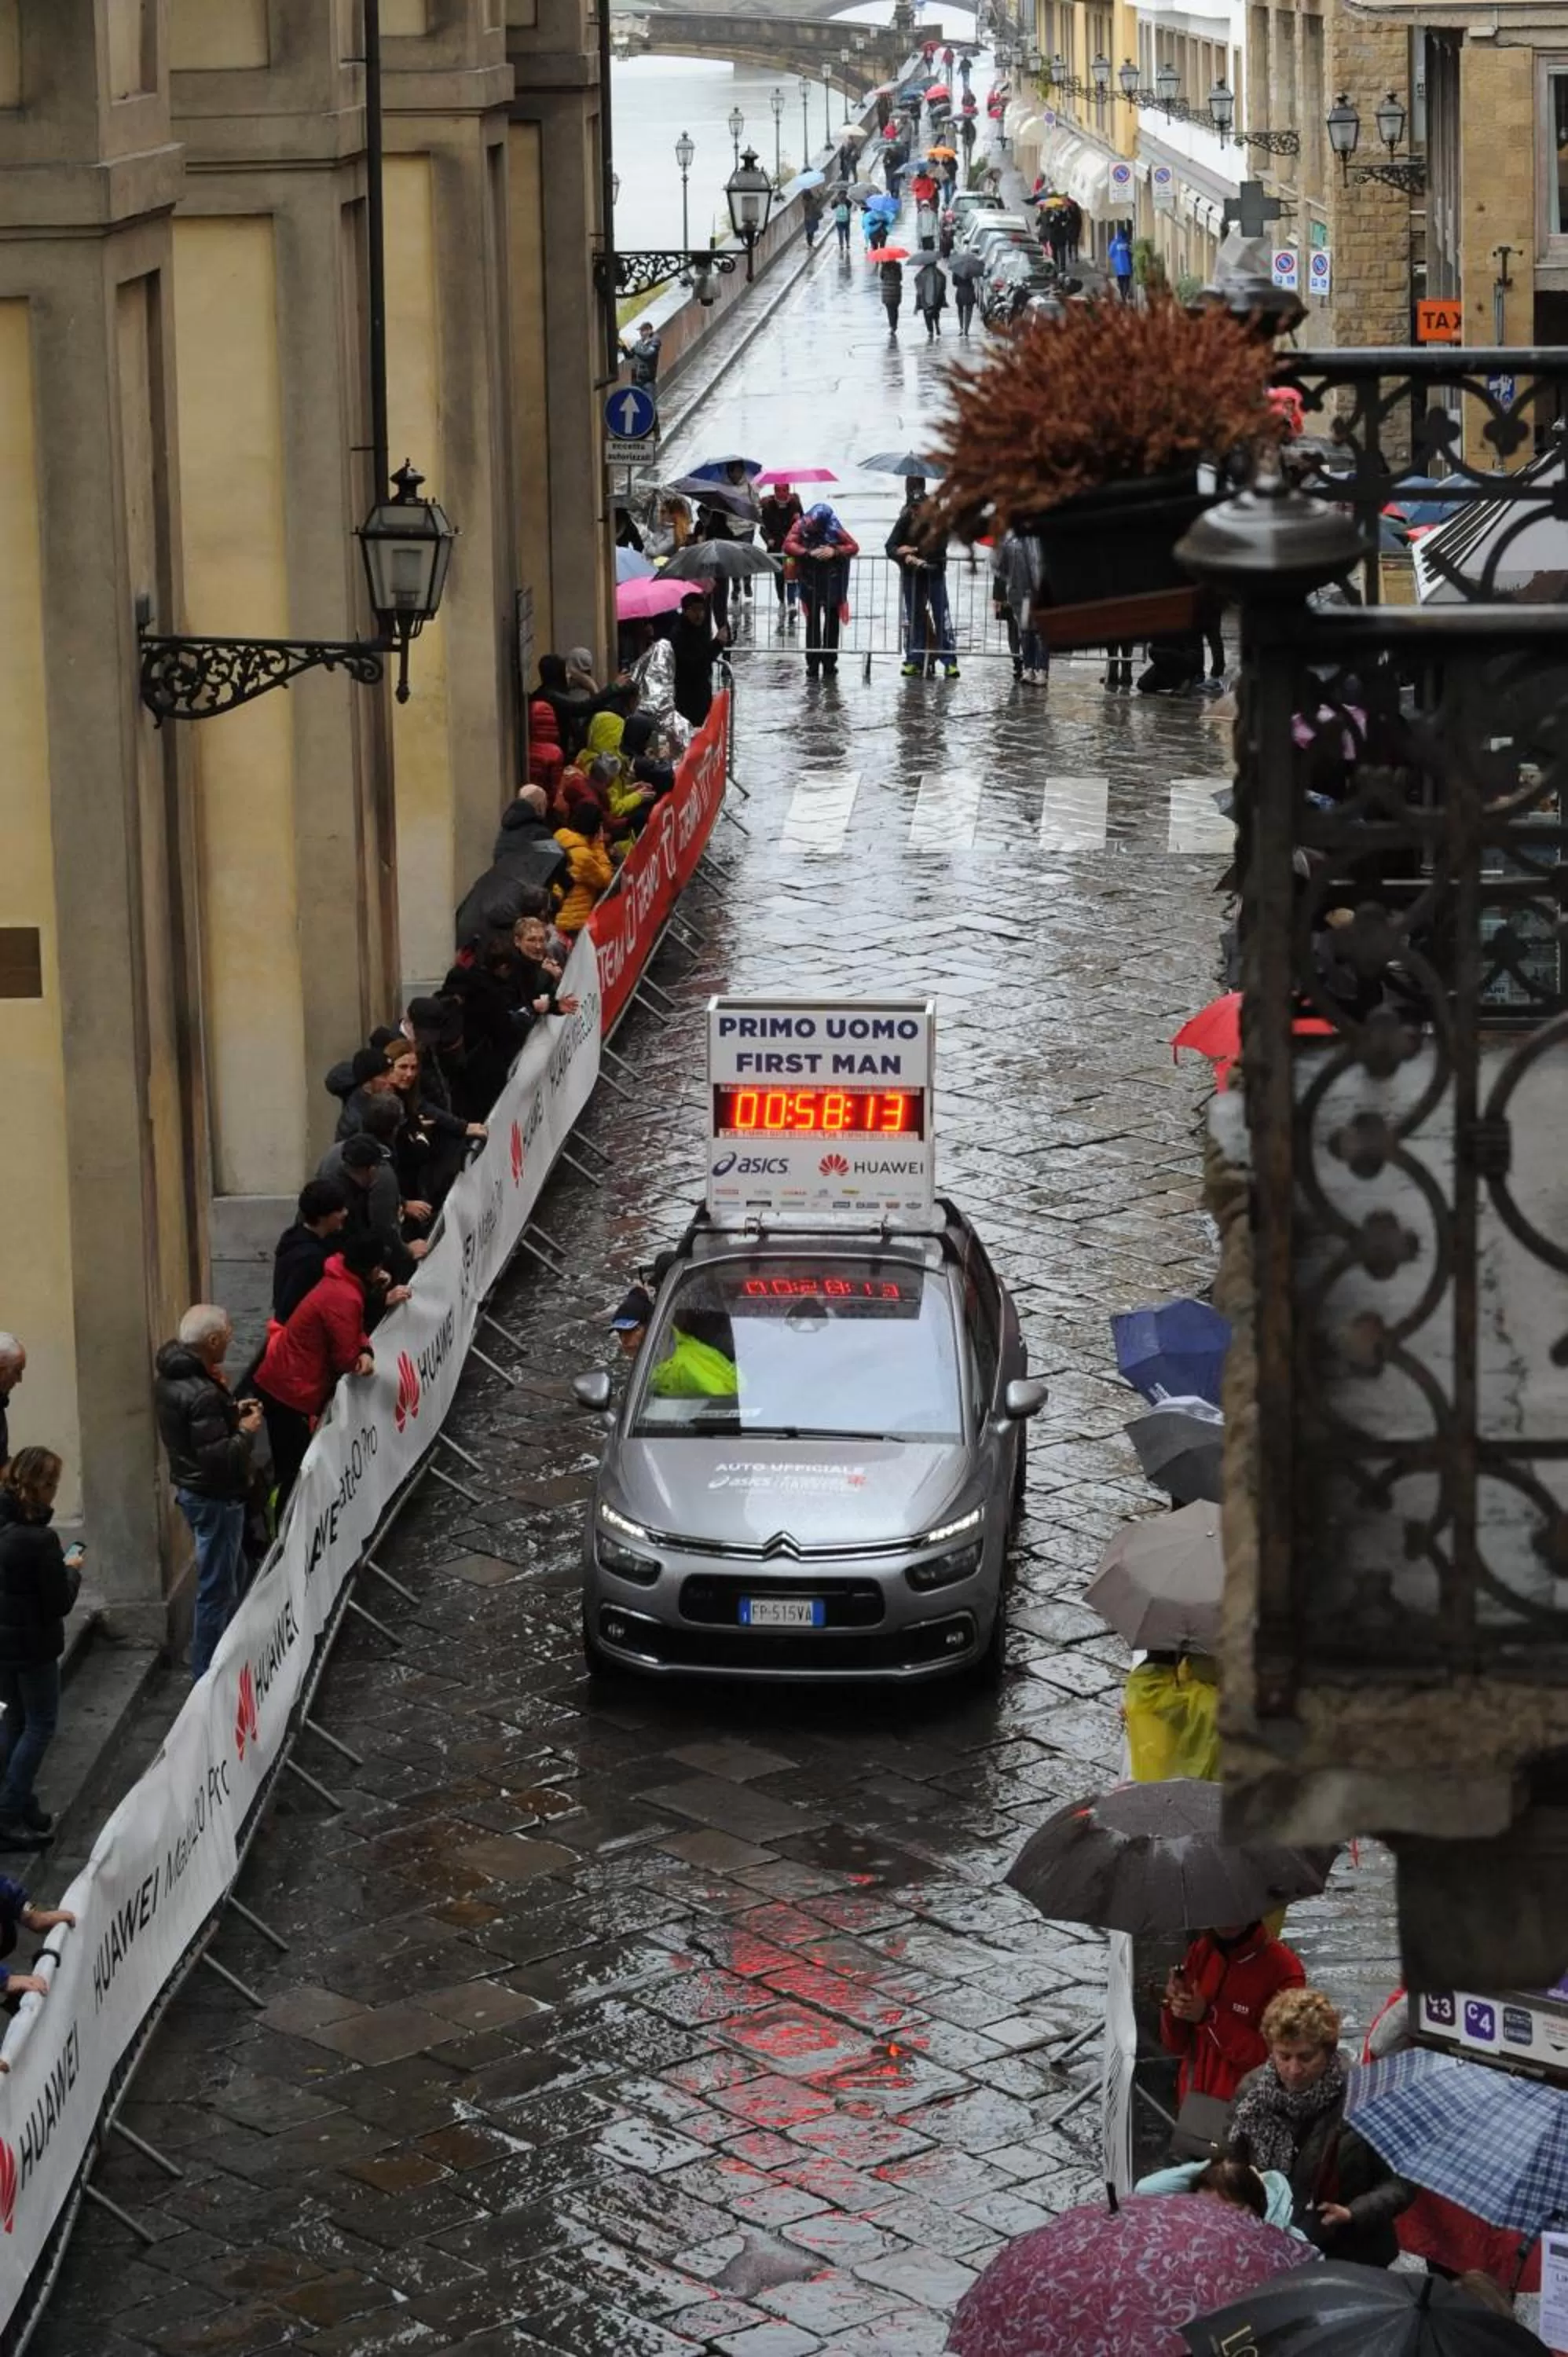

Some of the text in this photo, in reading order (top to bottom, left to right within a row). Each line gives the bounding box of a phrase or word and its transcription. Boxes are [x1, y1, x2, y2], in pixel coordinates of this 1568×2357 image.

[719, 1017, 918, 1040] PRIMO UOMO
[736, 1052, 901, 1075] FIRST MAN
[735, 1092, 905, 1131] 00:58:13
[854, 1160, 925, 1175] HUAWEI
[417, 1310, 456, 1387] HUAWEI
[715, 1462, 766, 1472] AUTO
[253, 1595, 300, 1710] HUAWEI
[93, 1864, 159, 2017] HUAWEI
[19, 2021, 80, 2176] HUAWEI
